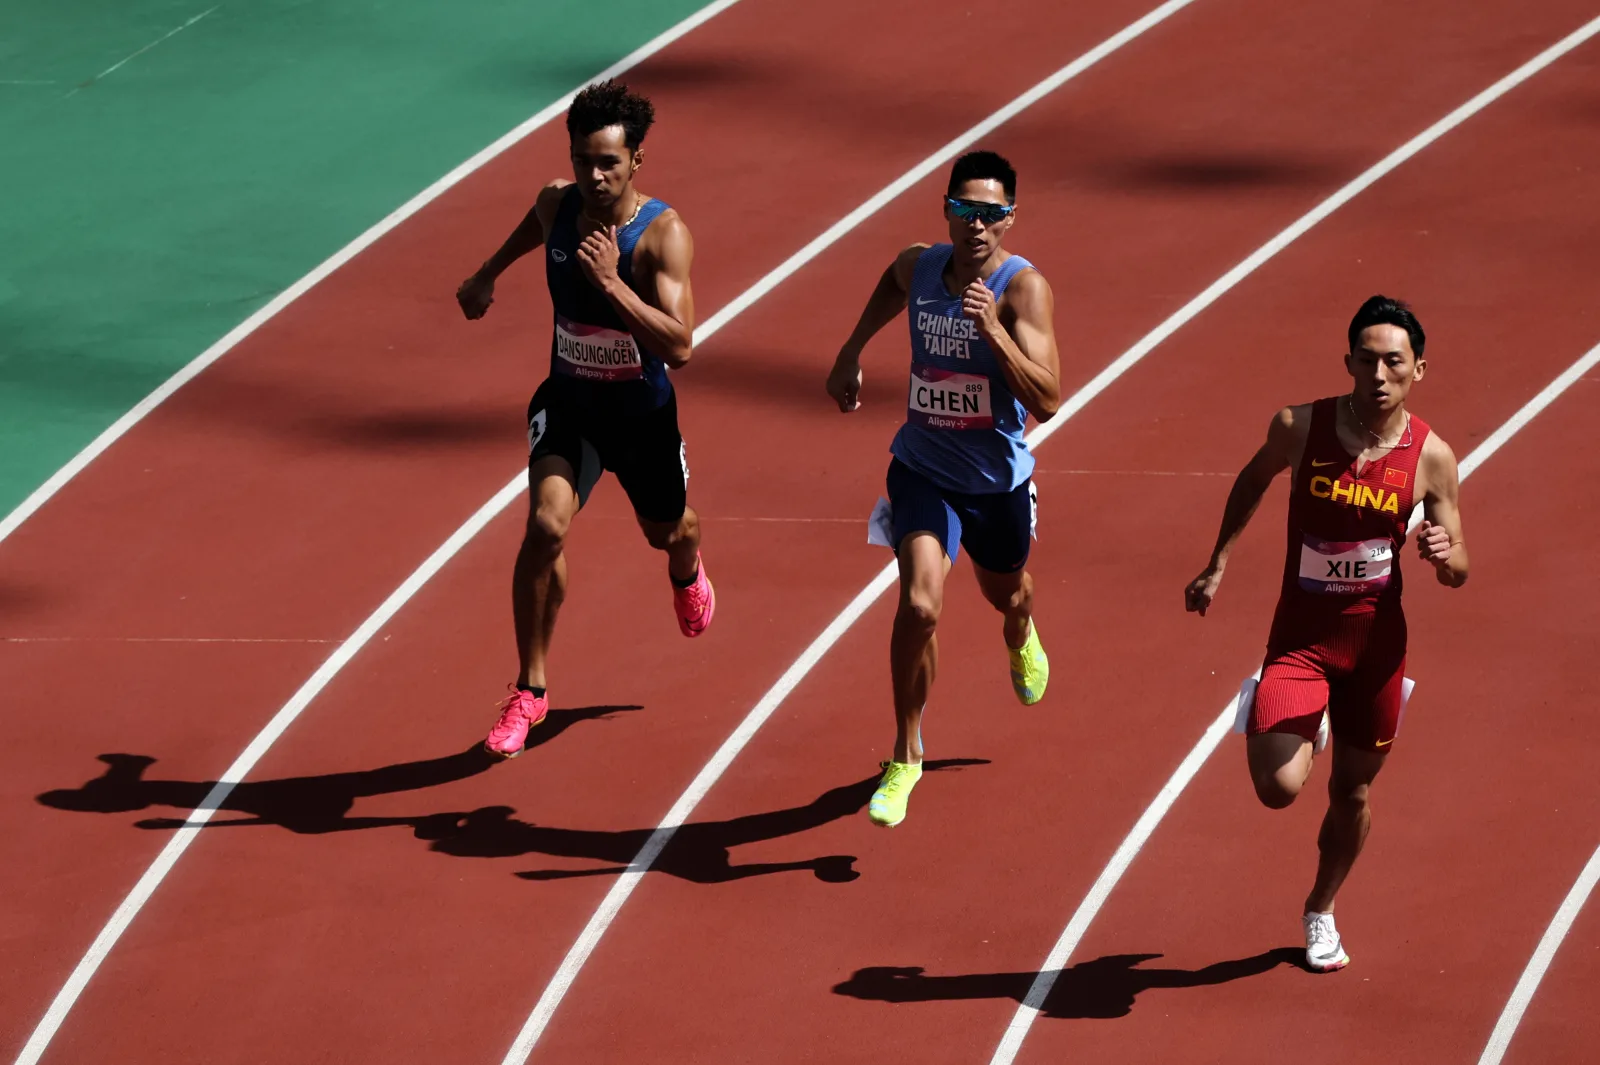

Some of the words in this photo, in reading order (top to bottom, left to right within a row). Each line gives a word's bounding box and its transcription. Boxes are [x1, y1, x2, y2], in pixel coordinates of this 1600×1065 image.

[917, 311, 979, 340] CHINESE
[558, 335, 637, 365] DANSUNGNOEN
[614, 340, 631, 348] 825
[923, 333, 971, 359] TAIPEI
[917, 386, 979, 413] CHEN
[965, 384, 983, 393] 889
[1309, 475, 1399, 514] CHINA
[1371, 546, 1385, 557] 210
[1326, 560, 1368, 578] XIE
